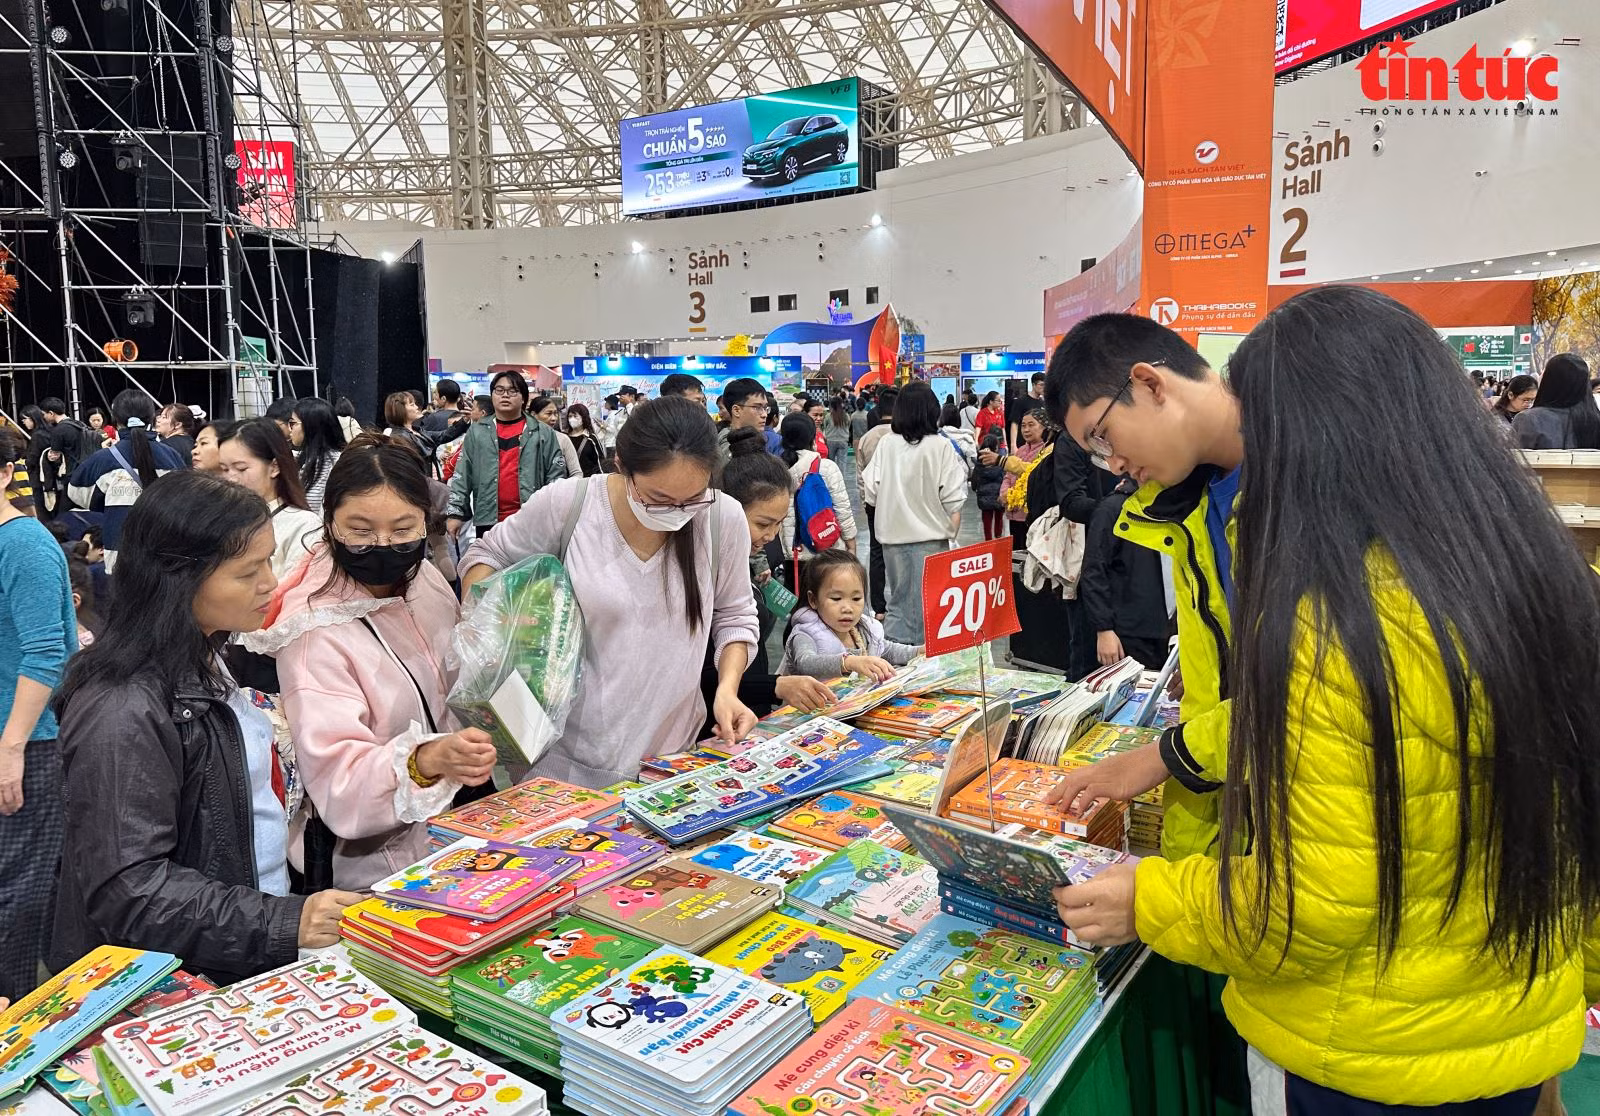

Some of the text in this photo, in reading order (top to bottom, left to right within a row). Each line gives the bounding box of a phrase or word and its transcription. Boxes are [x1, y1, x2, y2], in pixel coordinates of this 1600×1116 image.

[643, 116, 727, 159] CHUẨN 5 SAO
[1283, 129, 1350, 172] Sảnh
[644, 171, 674, 198] 253
[1282, 169, 1322, 199] Hall
[1280, 207, 1309, 264] 2
[688, 250, 729, 270] Sảnh
[688, 271, 713, 286] Hall
[689, 291, 706, 324] 3
[1182, 302, 1257, 312] THAIHABOOKS
[1182, 314, 1204, 322] Phụng
[958, 556, 988, 575] SALE
[937, 575, 1007, 640] 20%
[760, 930, 777, 944] con
[766, 926, 804, 953] Mèo Béo
[877, 968, 896, 982] Mê
[892, 951, 917, 969] cung
[911, 936, 931, 952] diệu
[897, 940, 948, 980] Lễ Phục sinh
[736, 979, 753, 991] và
[702, 990, 740, 1019] những
[728, 998, 760, 1020] Chim
[666, 1017, 707, 1041] người
[214, 1022, 362, 1088] Mê cung diệu kì
[216, 1019, 348, 1074] Trái tim yêu thương
[638, 1038, 672, 1057] bạn
[674, 1037, 705, 1056] Cụt
[774, 1073, 798, 1091] Mê
[796, 1049, 828, 1073] cung
[824, 1029, 849, 1050] diệu
[844, 1019, 861, 1030] kì
[795, 1030, 872, 1094] Câu chuyện cổ tích
